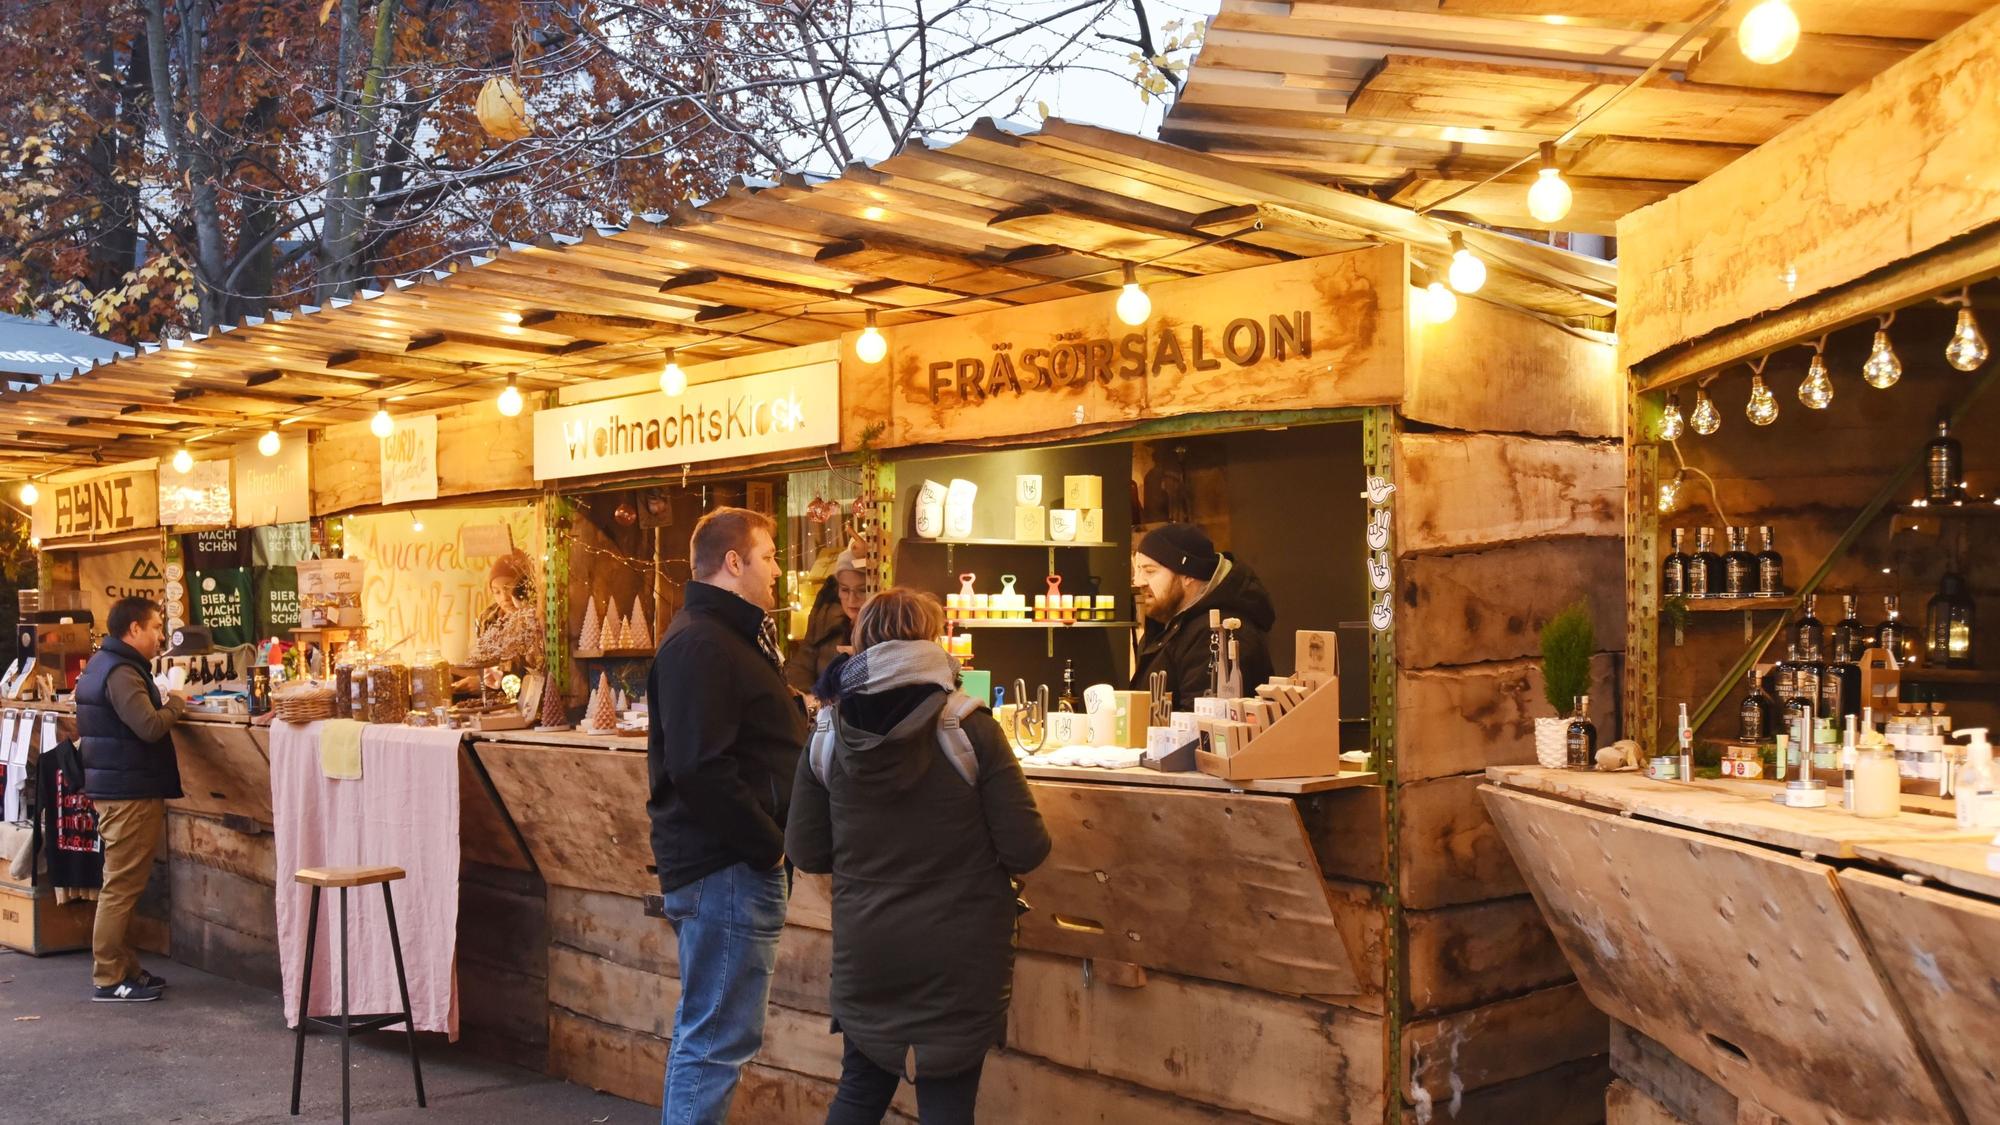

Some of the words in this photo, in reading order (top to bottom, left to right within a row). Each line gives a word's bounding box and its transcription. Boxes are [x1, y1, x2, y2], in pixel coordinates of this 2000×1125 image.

[928, 310, 1312, 404] FRÄSÖRSALON
[563, 386, 806, 462] WeihnachtsKiosk
[198, 530, 237, 540] MACHT
[198, 540, 237, 552] SCHÖN
[201, 593, 226, 605] BIER
[270, 590, 295, 601] BIER
[202, 603, 241, 617] MACHT
[270, 601, 301, 612] MACH
[203, 614, 241, 628] SCHÖN
